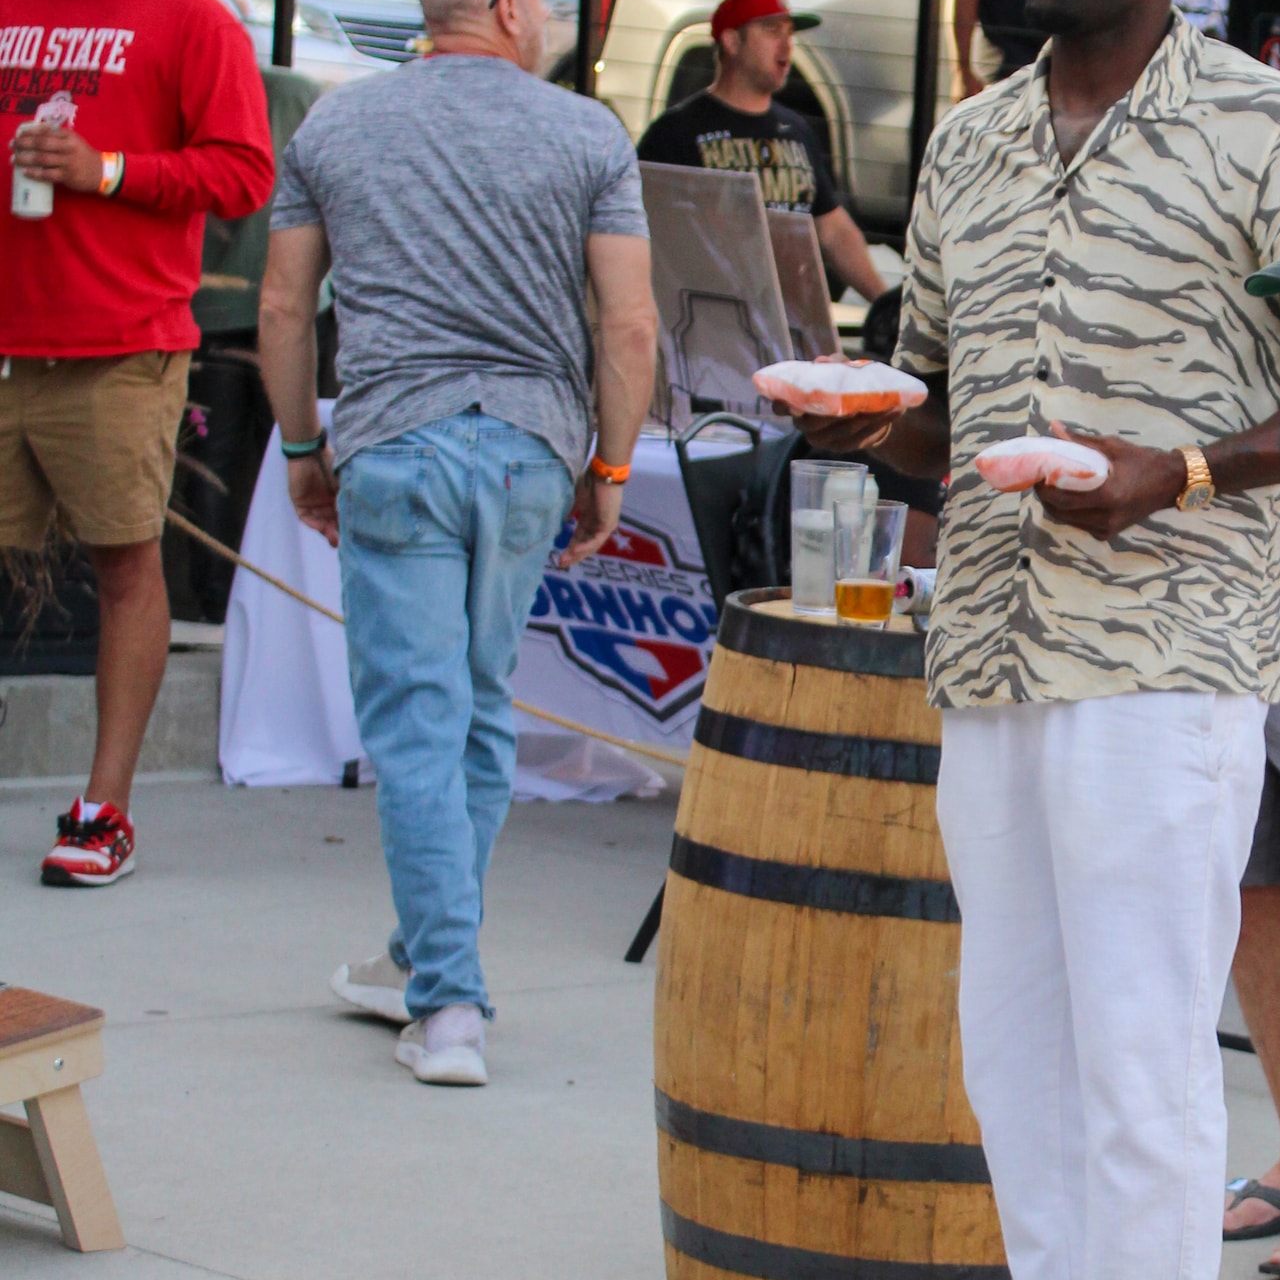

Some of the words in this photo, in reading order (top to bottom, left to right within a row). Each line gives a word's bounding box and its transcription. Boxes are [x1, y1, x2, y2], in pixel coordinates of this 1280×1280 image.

[0, 25, 45, 70] HIO
[42, 26, 135, 76] STATE
[0, 68, 101, 97] UCKEYES
[701, 137, 814, 171] NATIONA
[583, 556, 695, 597] SERIES
